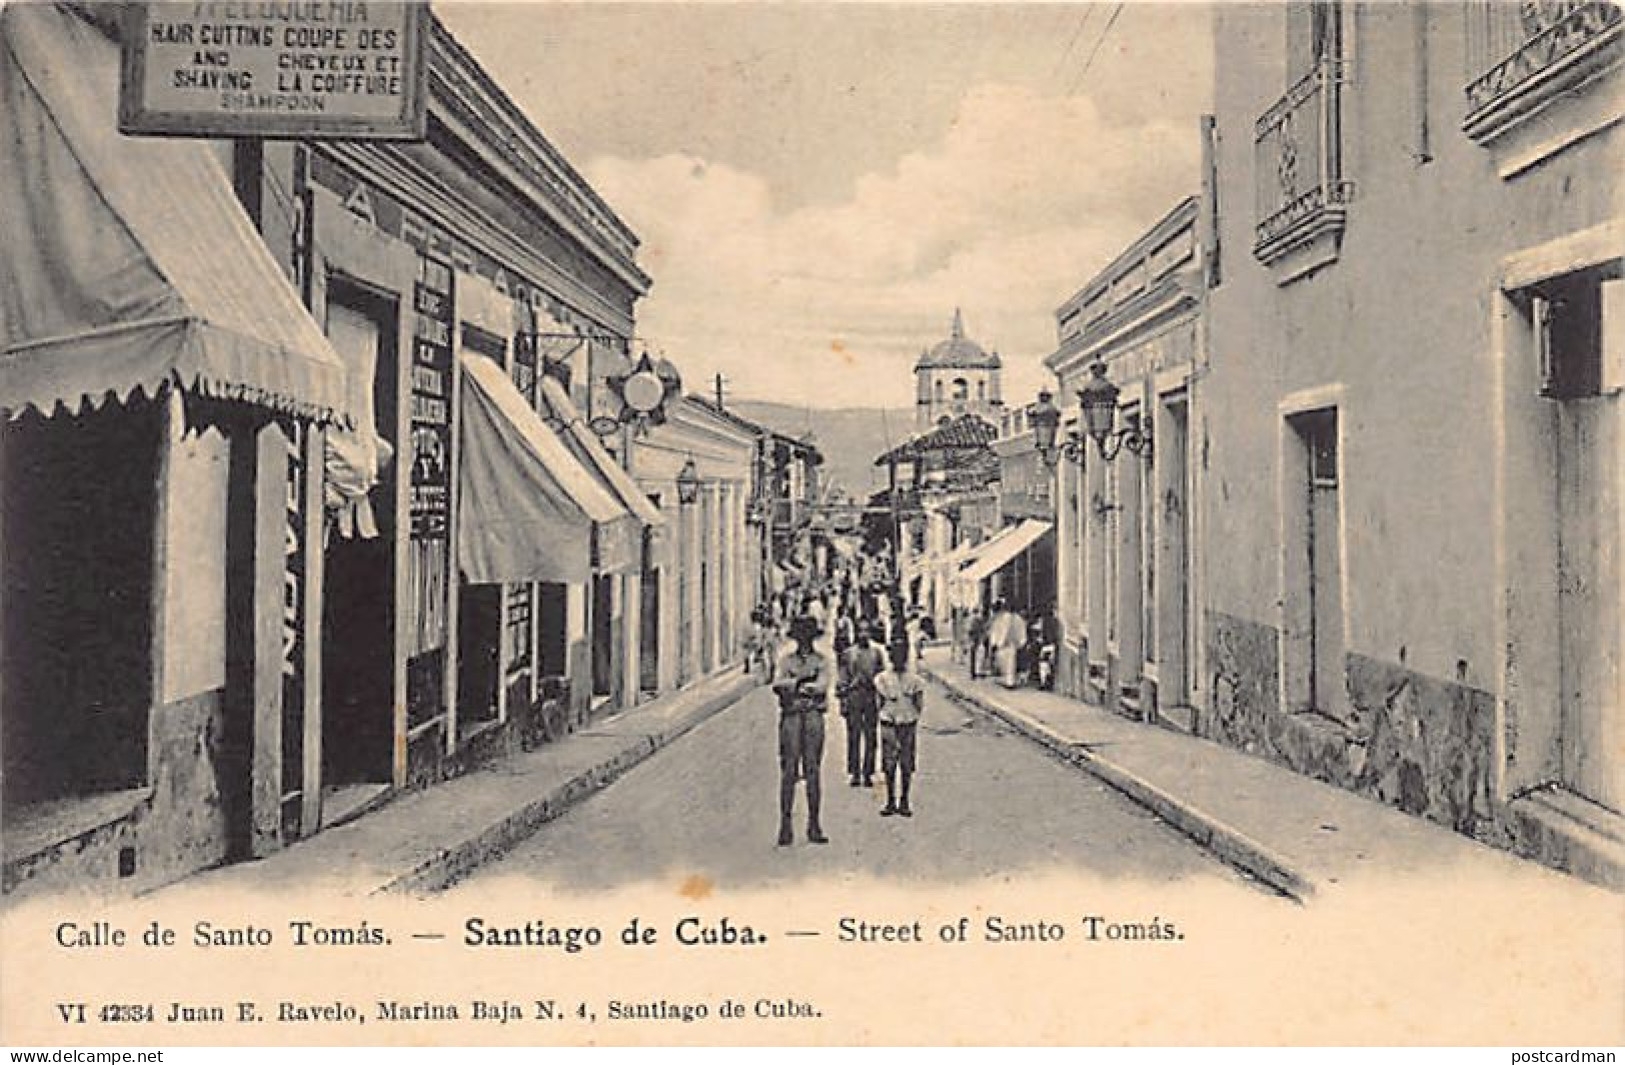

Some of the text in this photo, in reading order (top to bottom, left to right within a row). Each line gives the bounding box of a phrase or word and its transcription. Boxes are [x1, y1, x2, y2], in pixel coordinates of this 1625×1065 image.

[151, 24, 274, 47] HAIR CUTTING
[283, 27, 397, 50] COUPE DES
[193, 51, 229, 66] AND
[277, 53, 399, 73] CHEVEUX ET
[173, 69, 252, 91] SHAVING
[277, 73, 400, 95] LA COIFFURE
